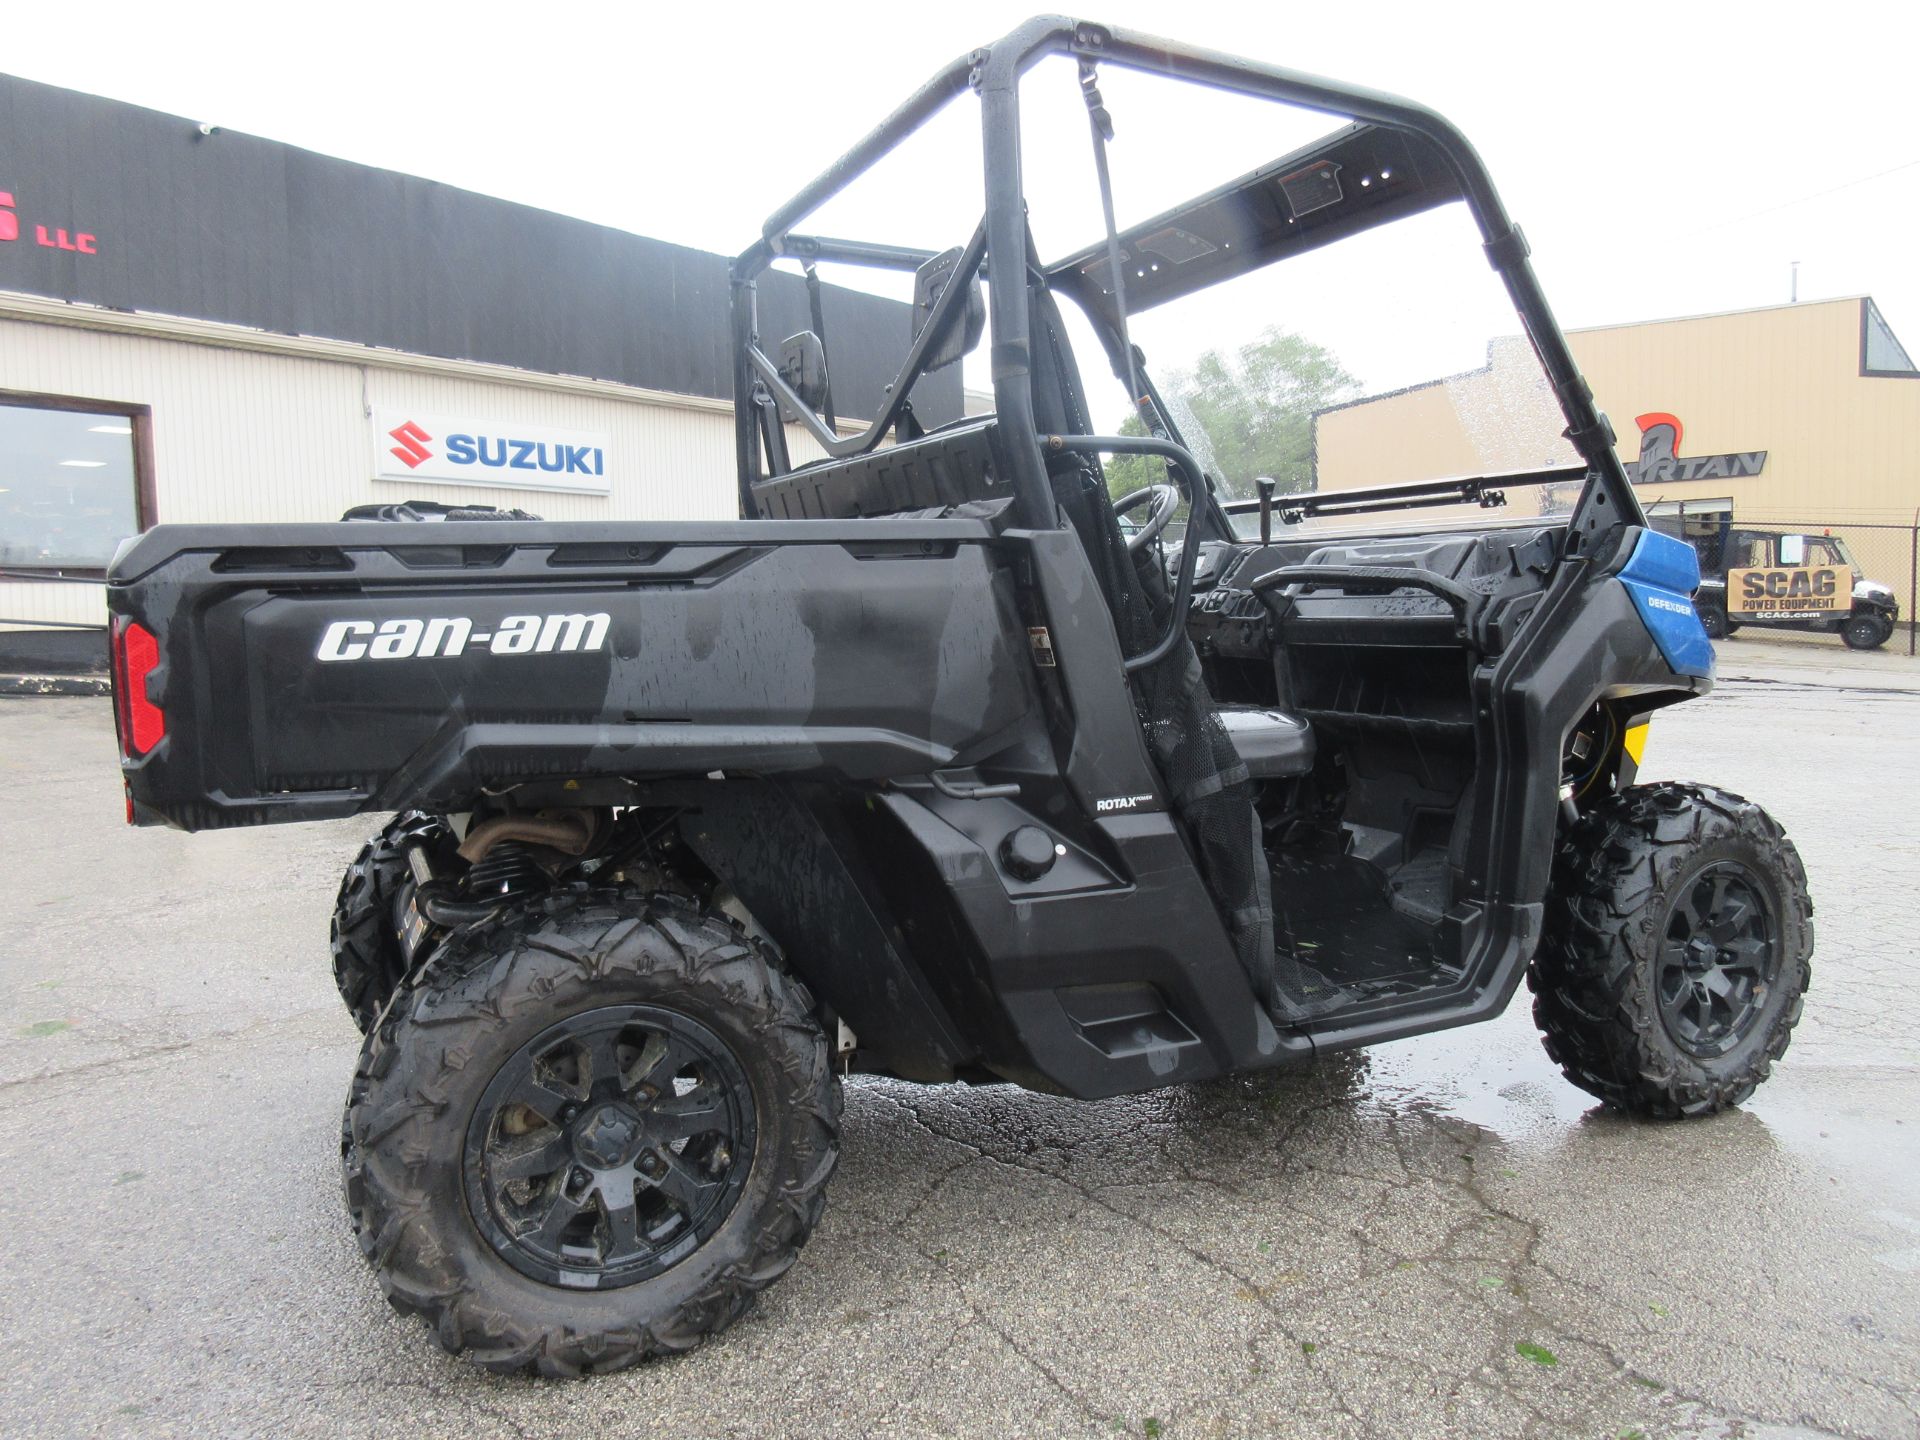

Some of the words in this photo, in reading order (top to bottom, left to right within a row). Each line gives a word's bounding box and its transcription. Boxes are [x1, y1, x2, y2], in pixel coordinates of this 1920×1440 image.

[36, 224, 97, 255] LLC
[446, 434, 604, 476] SUZUKI
[1743, 570, 1836, 599] SCAG
[1742, 599, 1776, 610] POWER
[1779, 598, 1836, 610] EQUIPMENT
[1756, 611, 1820, 619] SCAG.com
[317, 612, 611, 661] can-am
[1097, 797, 1136, 811] ROTAX
